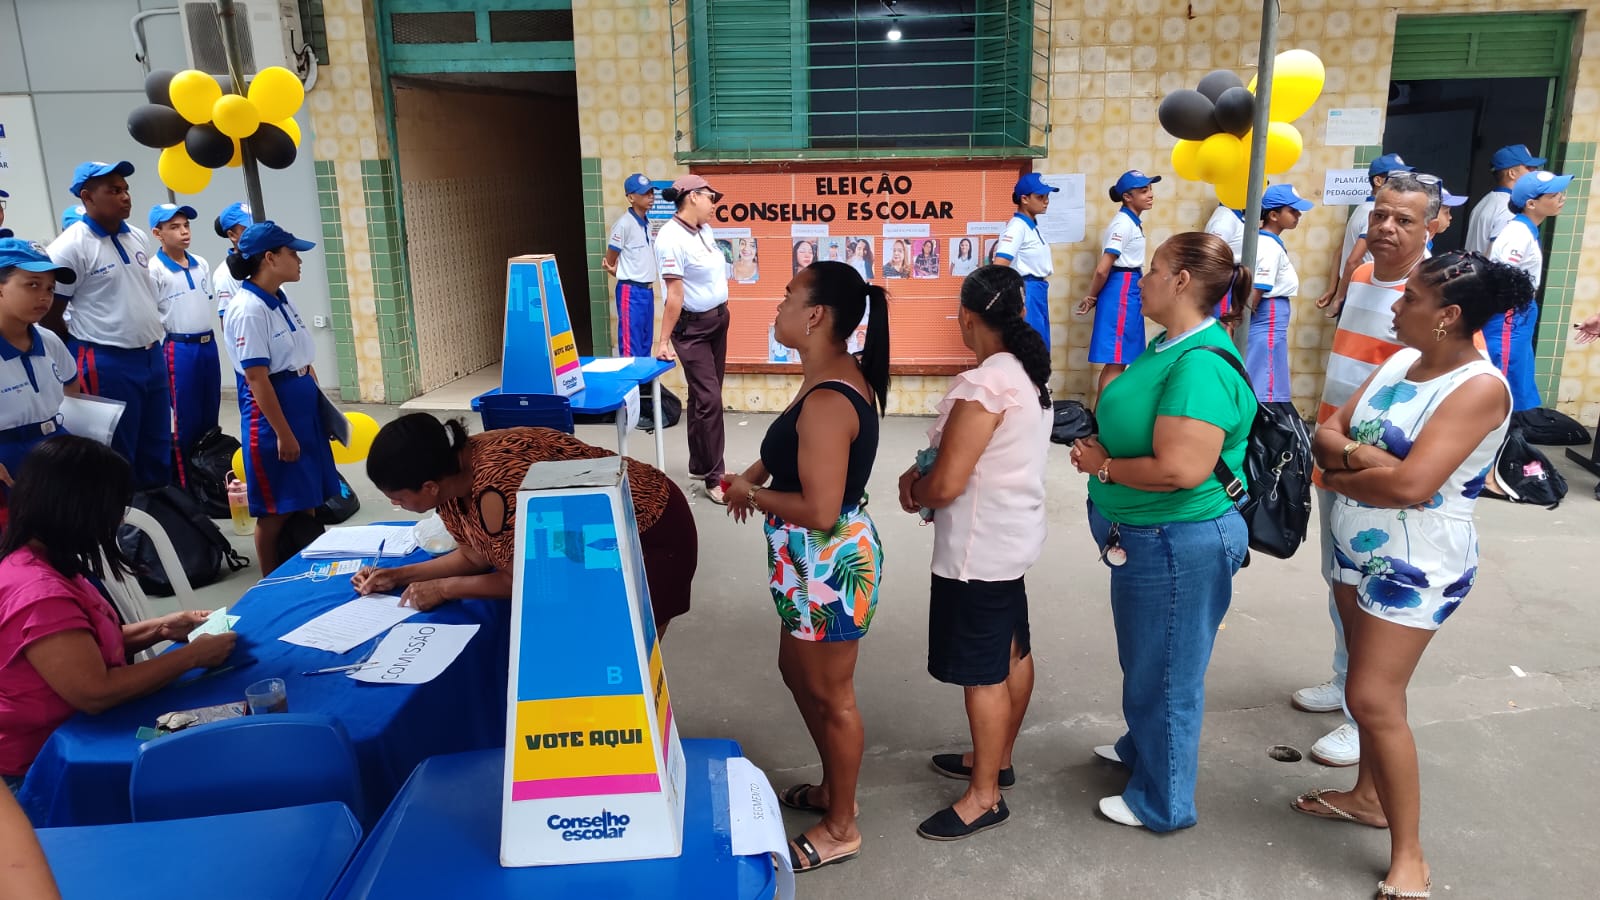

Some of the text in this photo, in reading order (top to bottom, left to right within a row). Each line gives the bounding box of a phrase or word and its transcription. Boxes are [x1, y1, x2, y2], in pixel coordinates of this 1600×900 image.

[815, 173, 913, 198] ELEIÇÃO
[1334, 176, 1370, 184] PLANTÃO
[1326, 188, 1371, 196] PEDAGÓGIC
[715, 201, 954, 223] CONSELHO ESCOLAR
[381, 626, 436, 680] COMISSÃO
[607, 666, 623, 685] B
[525, 728, 643, 751] VOTE AQUI
[750, 783, 764, 820] SEGMENTO
[547, 808, 631, 830] Conselho
[562, 825, 626, 842] escolar
